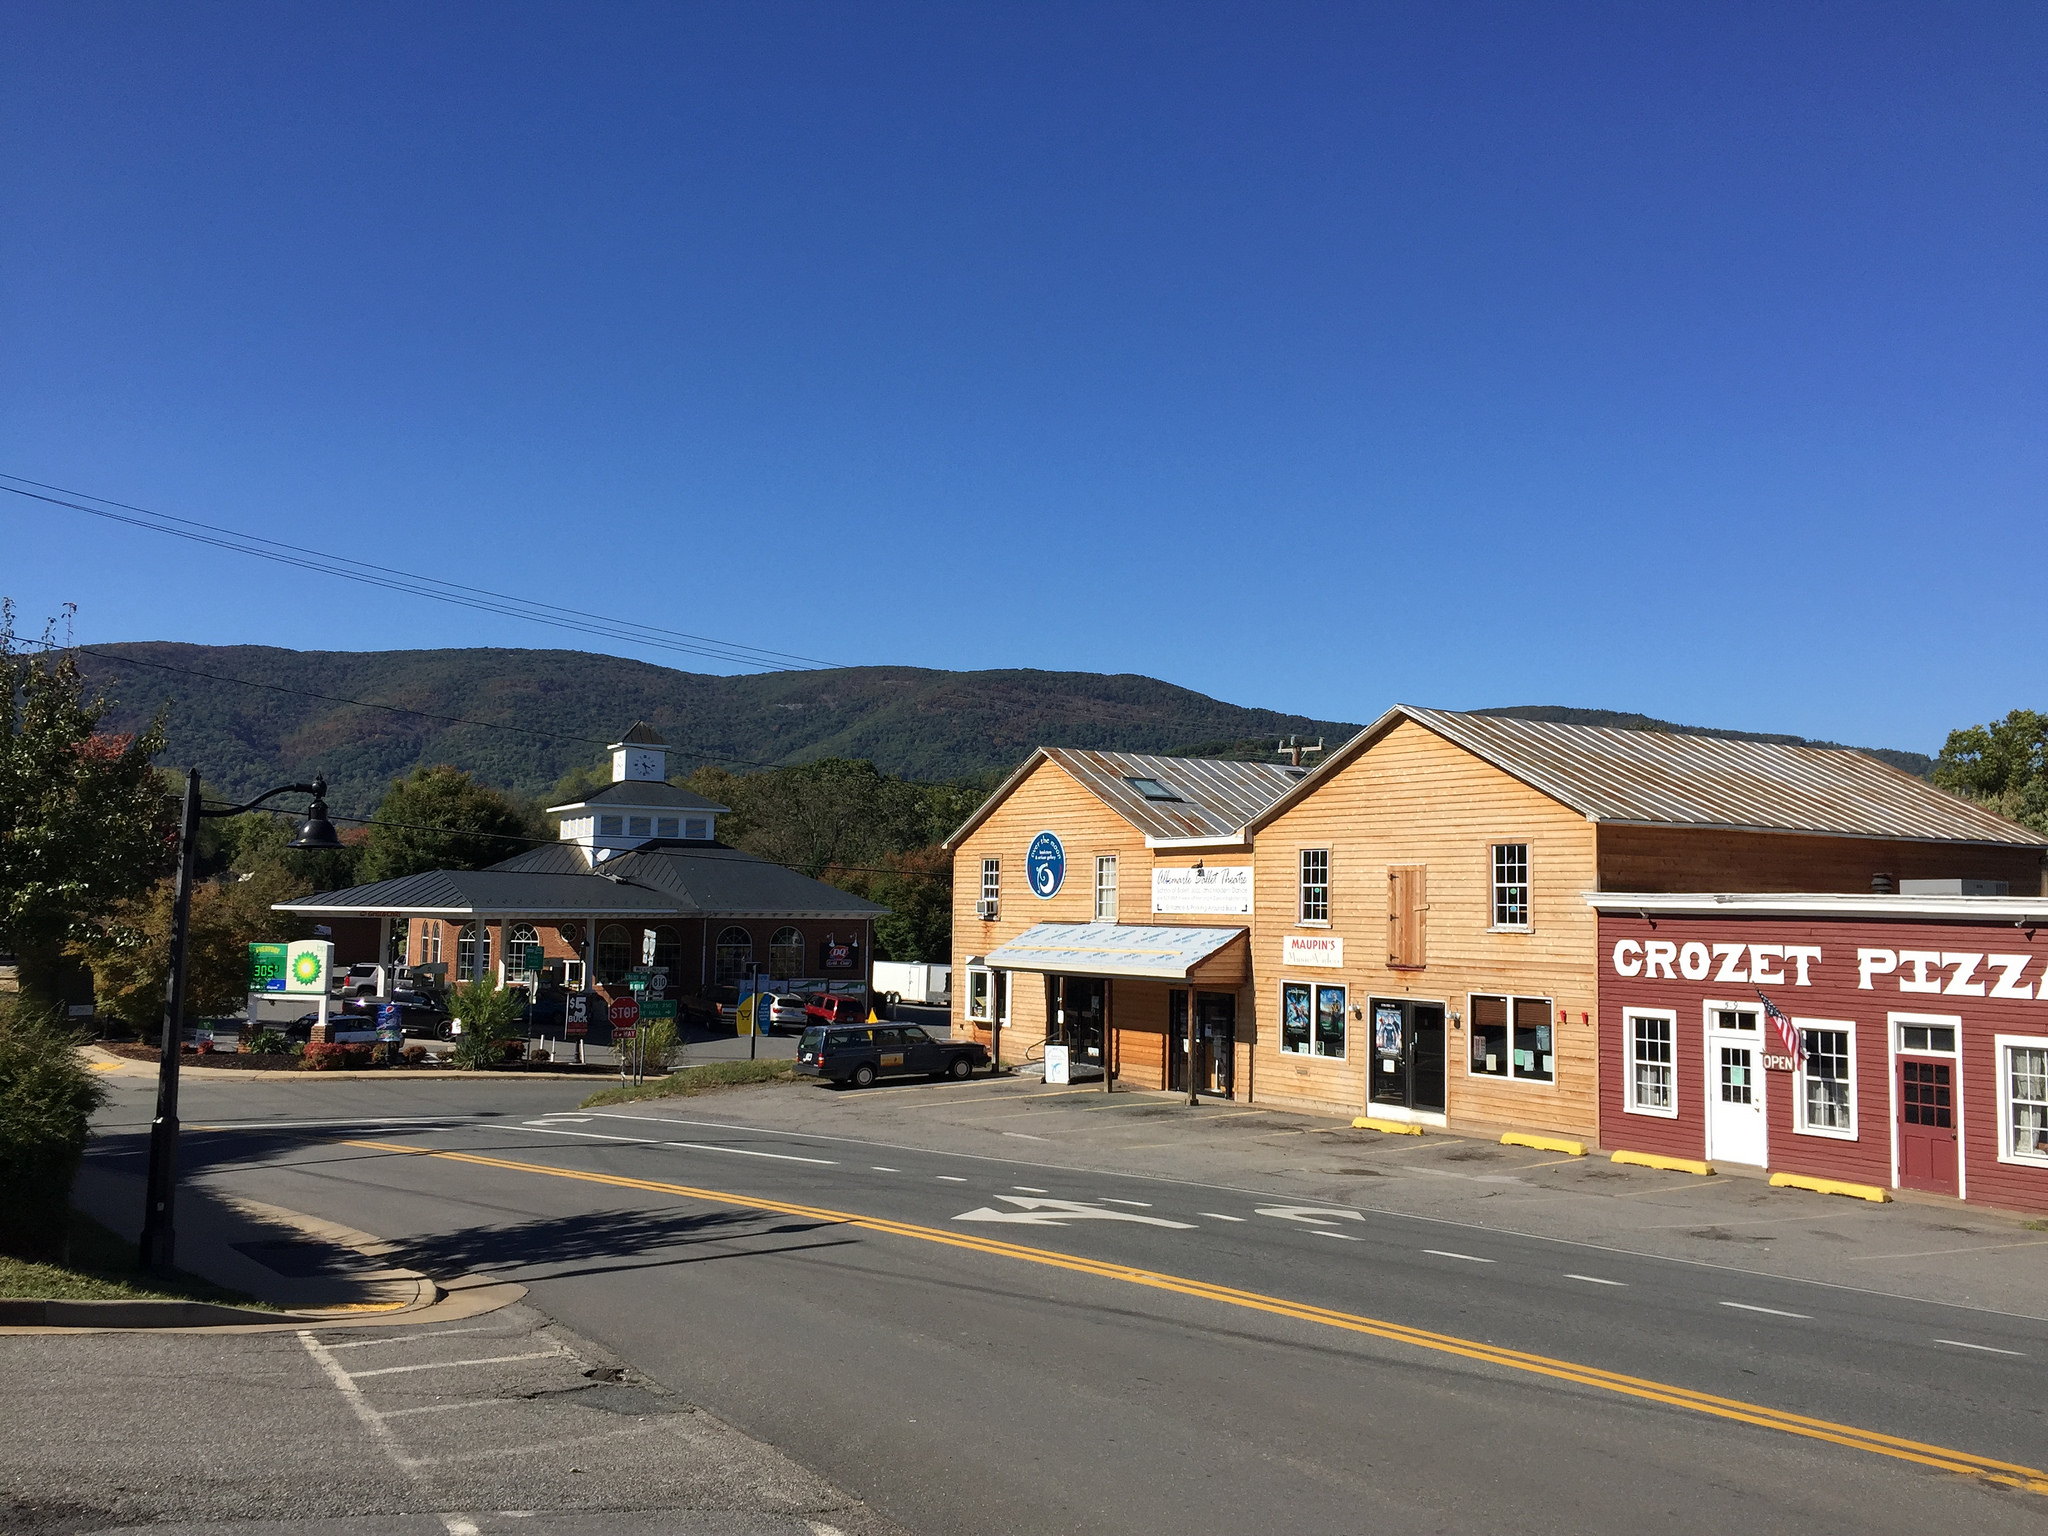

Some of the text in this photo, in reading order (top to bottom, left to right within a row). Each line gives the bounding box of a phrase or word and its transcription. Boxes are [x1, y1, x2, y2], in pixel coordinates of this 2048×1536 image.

[1031, 835, 1062, 860] over the moon
[1157, 868, 1248, 885] Albemarle Ballet Theatre
[1291, 938, 1336, 951] MAUPIN'S
[1612, 939, 2048, 1000] CROZET PIZZ
[653, 978, 666, 986] 810
[569, 996, 587, 1018] $5
[611, 1007, 639, 1019] STOP
[568, 1015, 588, 1023] BUCK
[1763, 1054, 1793, 1071] OPEN
